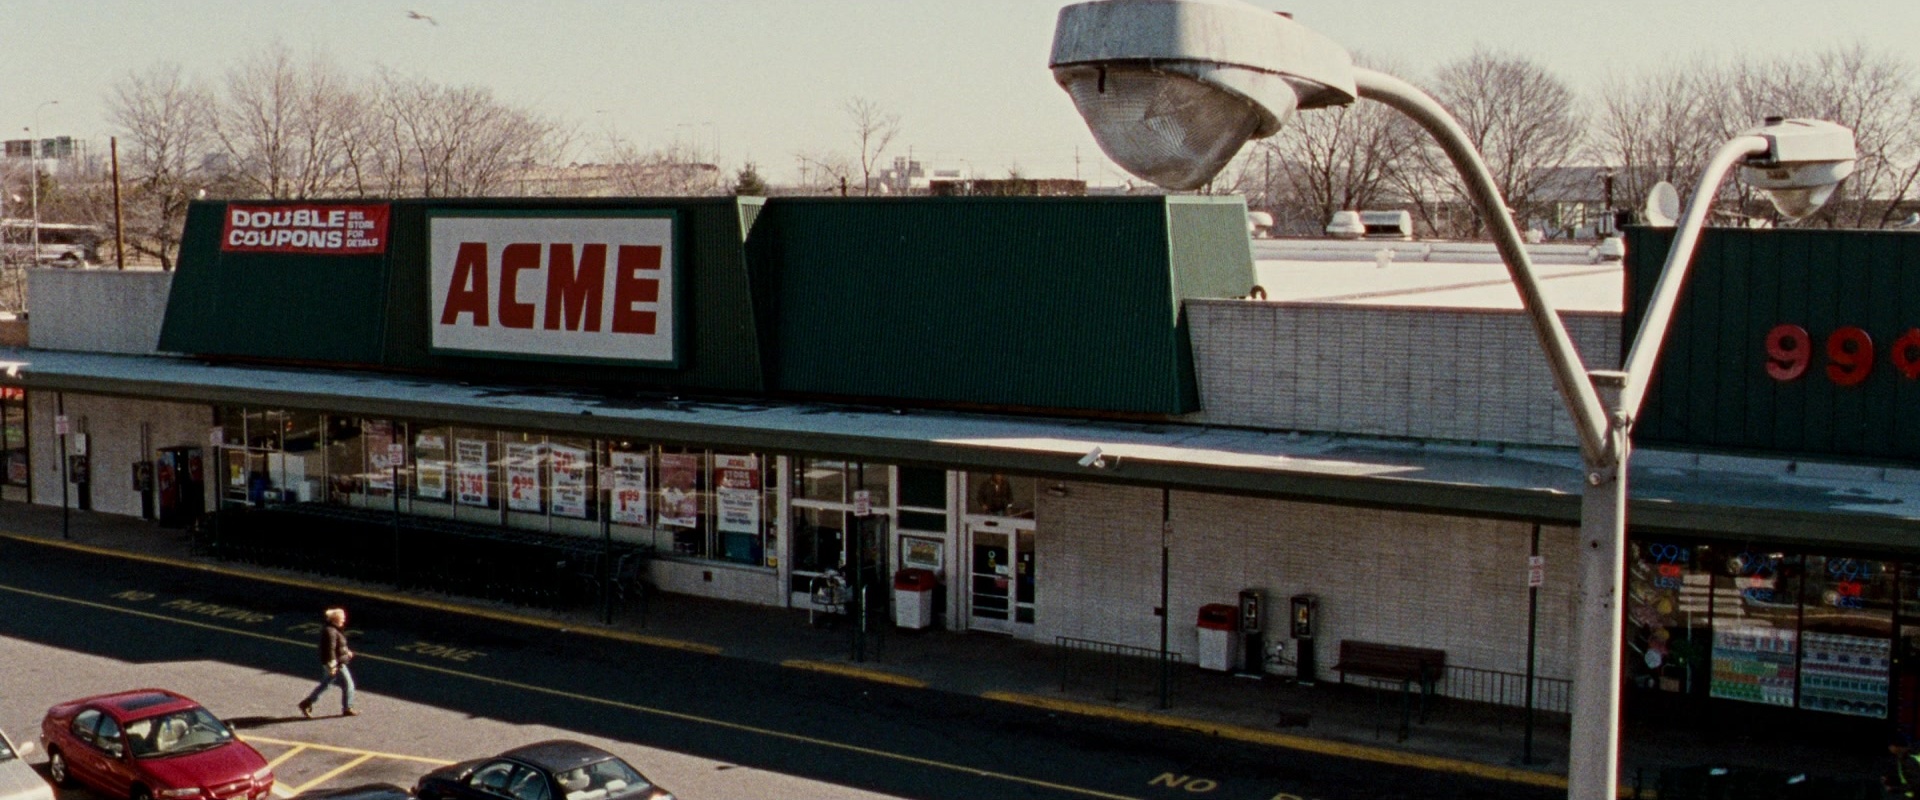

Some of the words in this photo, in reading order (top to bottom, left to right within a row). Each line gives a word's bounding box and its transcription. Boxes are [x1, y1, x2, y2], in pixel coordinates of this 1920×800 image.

[232, 210, 345, 227] DOUBLE
[346, 220, 375, 229] STORE
[229, 229, 343, 248] COUPONS
[347, 230, 365, 238] FOR
[440, 242, 662, 335] ACME
[110, 590, 156, 602] NO
[160, 598, 275, 624] PARKING
[393, 640, 489, 662] ZONE
[1148, 772, 1218, 793] NO
